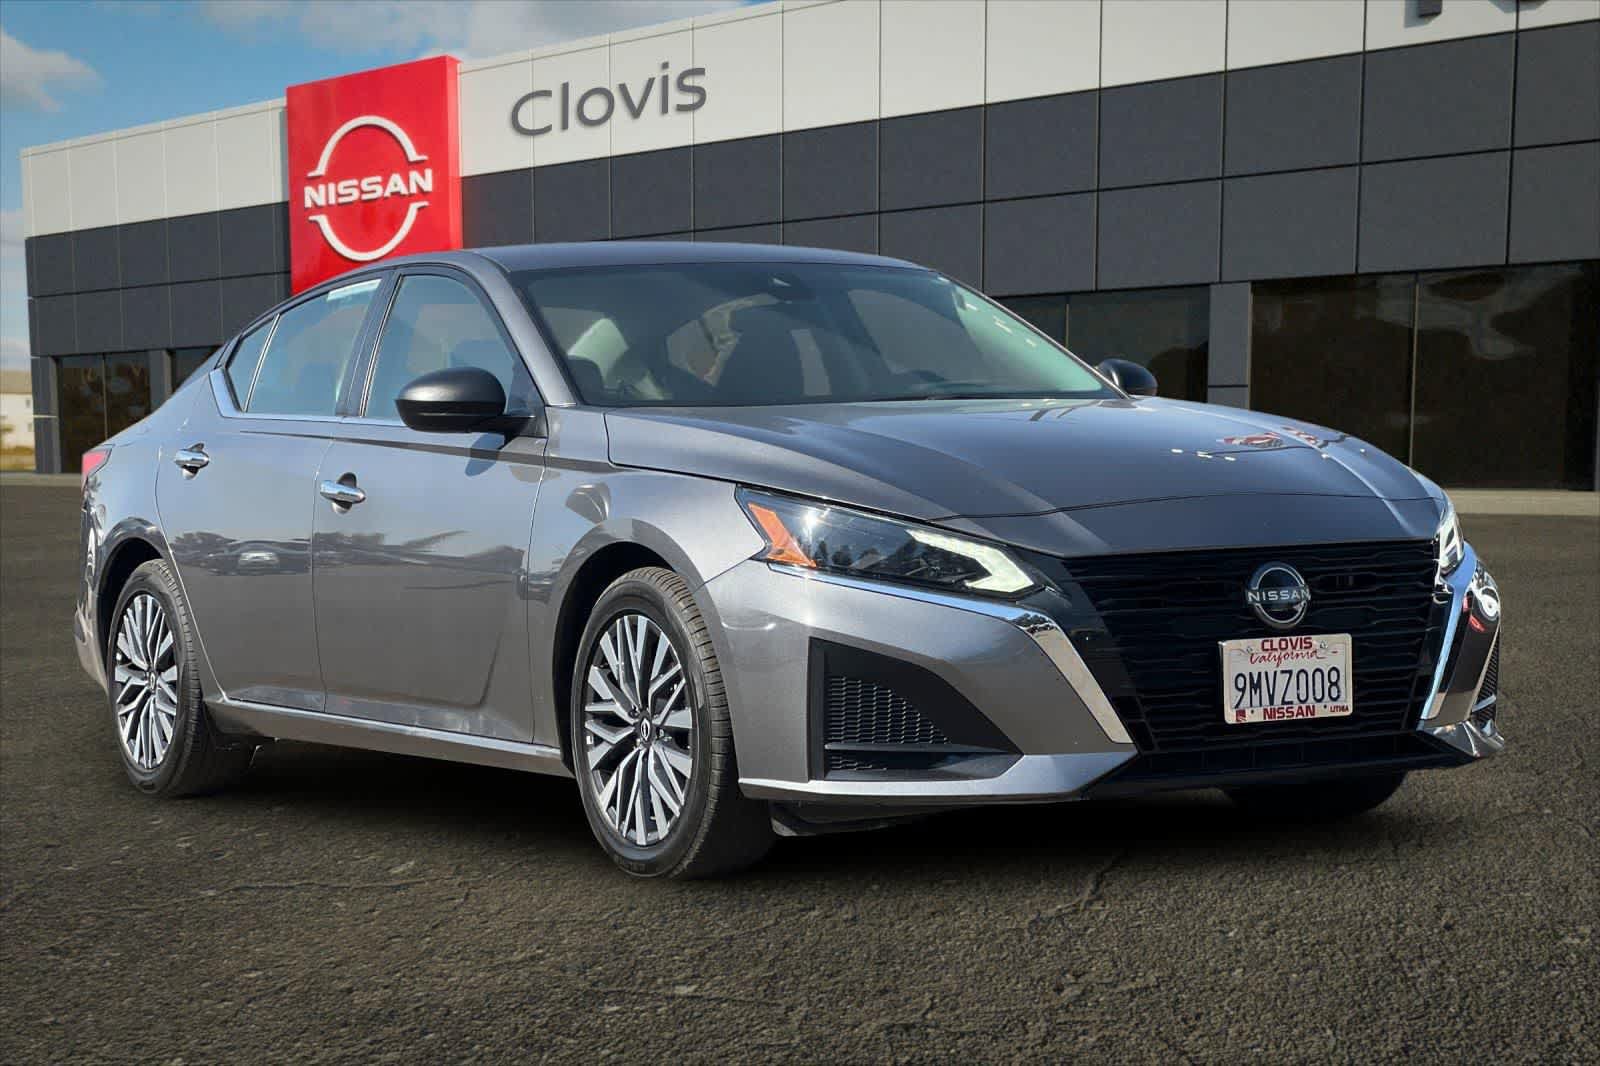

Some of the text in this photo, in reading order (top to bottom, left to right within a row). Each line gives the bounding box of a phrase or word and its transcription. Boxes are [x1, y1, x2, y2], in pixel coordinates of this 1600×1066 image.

[511, 61, 707, 137] Clovis
[303, 168, 433, 208] NISSAN
[1247, 589, 1311, 602] NISSAN
[1261, 637, 1313, 652] CLOVIS
[1250, 649, 1326, 667] California
[1234, 666, 1341, 709] 9MVZ008
[1263, 705, 1316, 720] NISSAN
